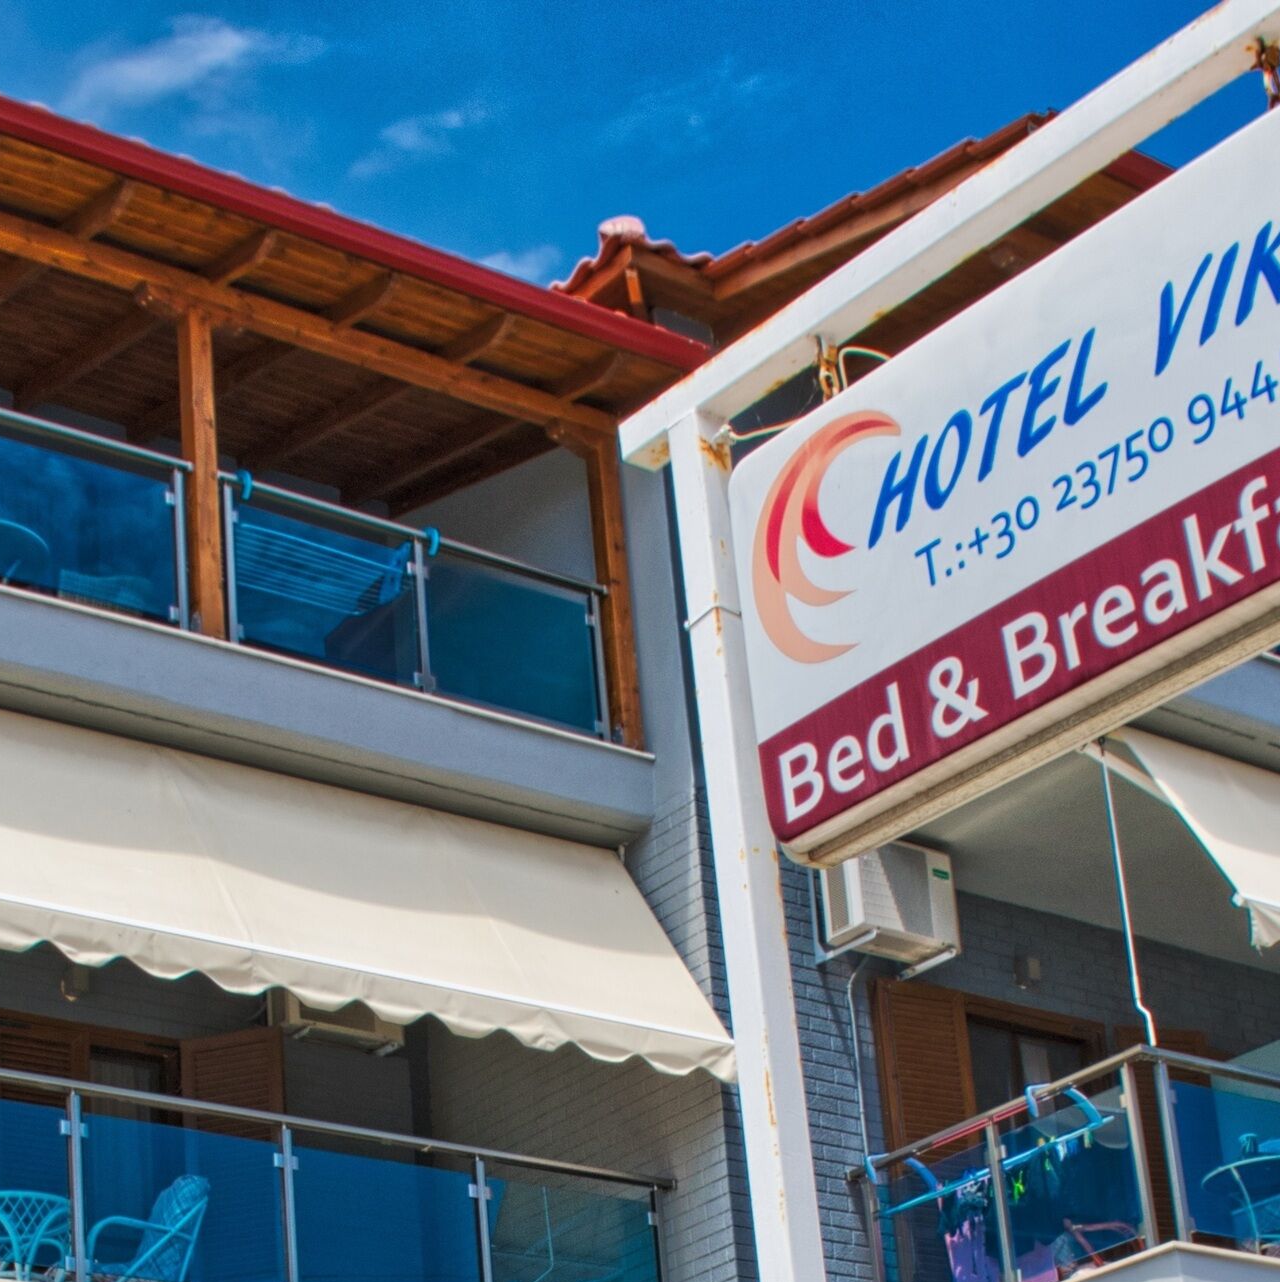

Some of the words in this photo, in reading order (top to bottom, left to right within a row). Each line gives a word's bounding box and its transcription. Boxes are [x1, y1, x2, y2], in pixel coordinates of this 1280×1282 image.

[866, 326, 1110, 550] HOTEL
[1051, 415, 1177, 512] 23750
[777, 682, 910, 824] Bed
[928, 656, 989, 739] &
